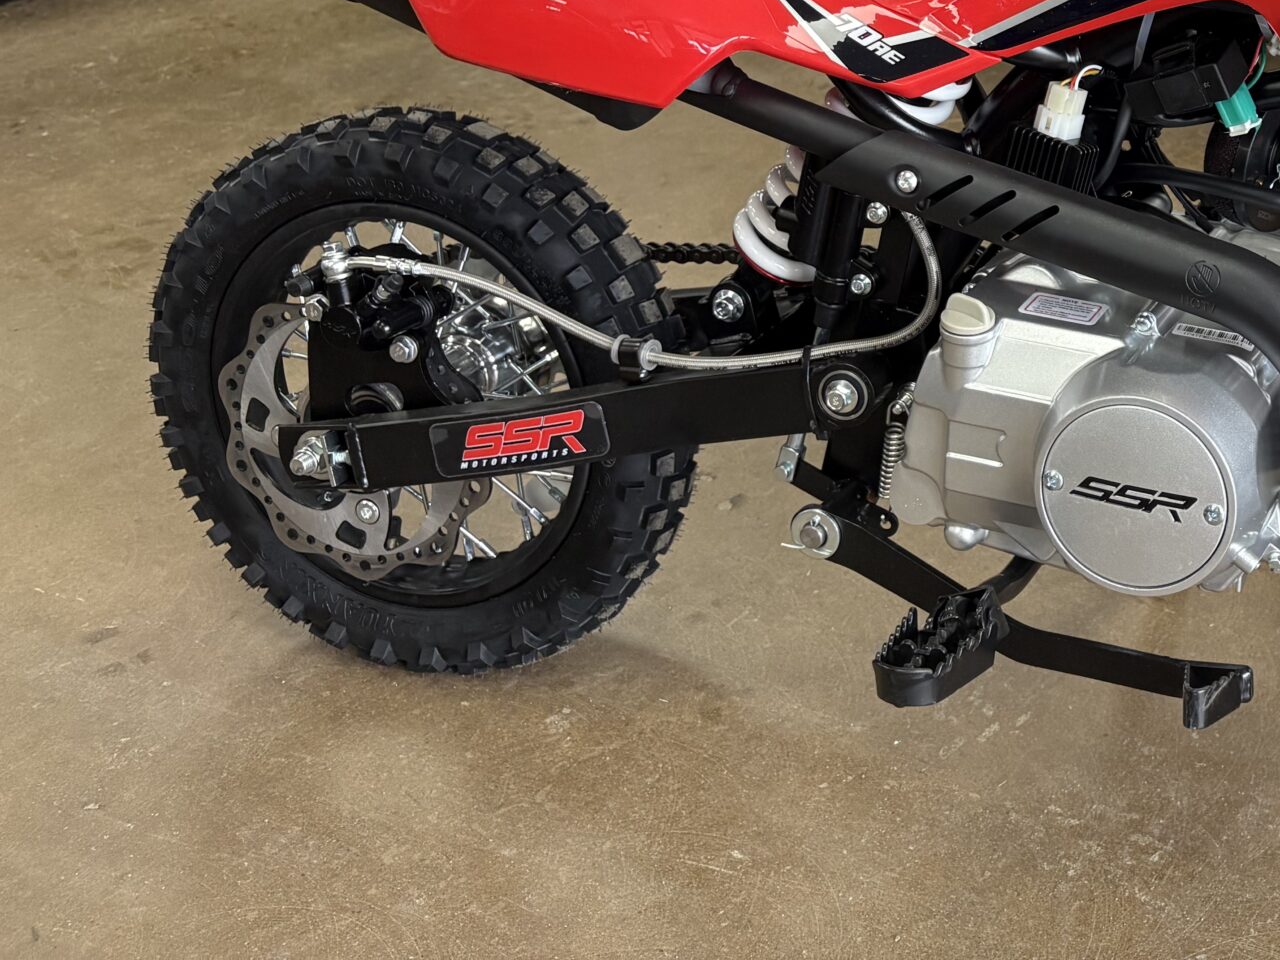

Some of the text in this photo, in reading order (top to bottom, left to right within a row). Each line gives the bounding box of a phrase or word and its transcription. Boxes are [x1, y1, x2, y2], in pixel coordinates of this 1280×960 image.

[461, 409, 587, 461] SSR
[460, 448, 569, 470] MOTORSPORTS
[1069, 476, 1198, 523] SSR
